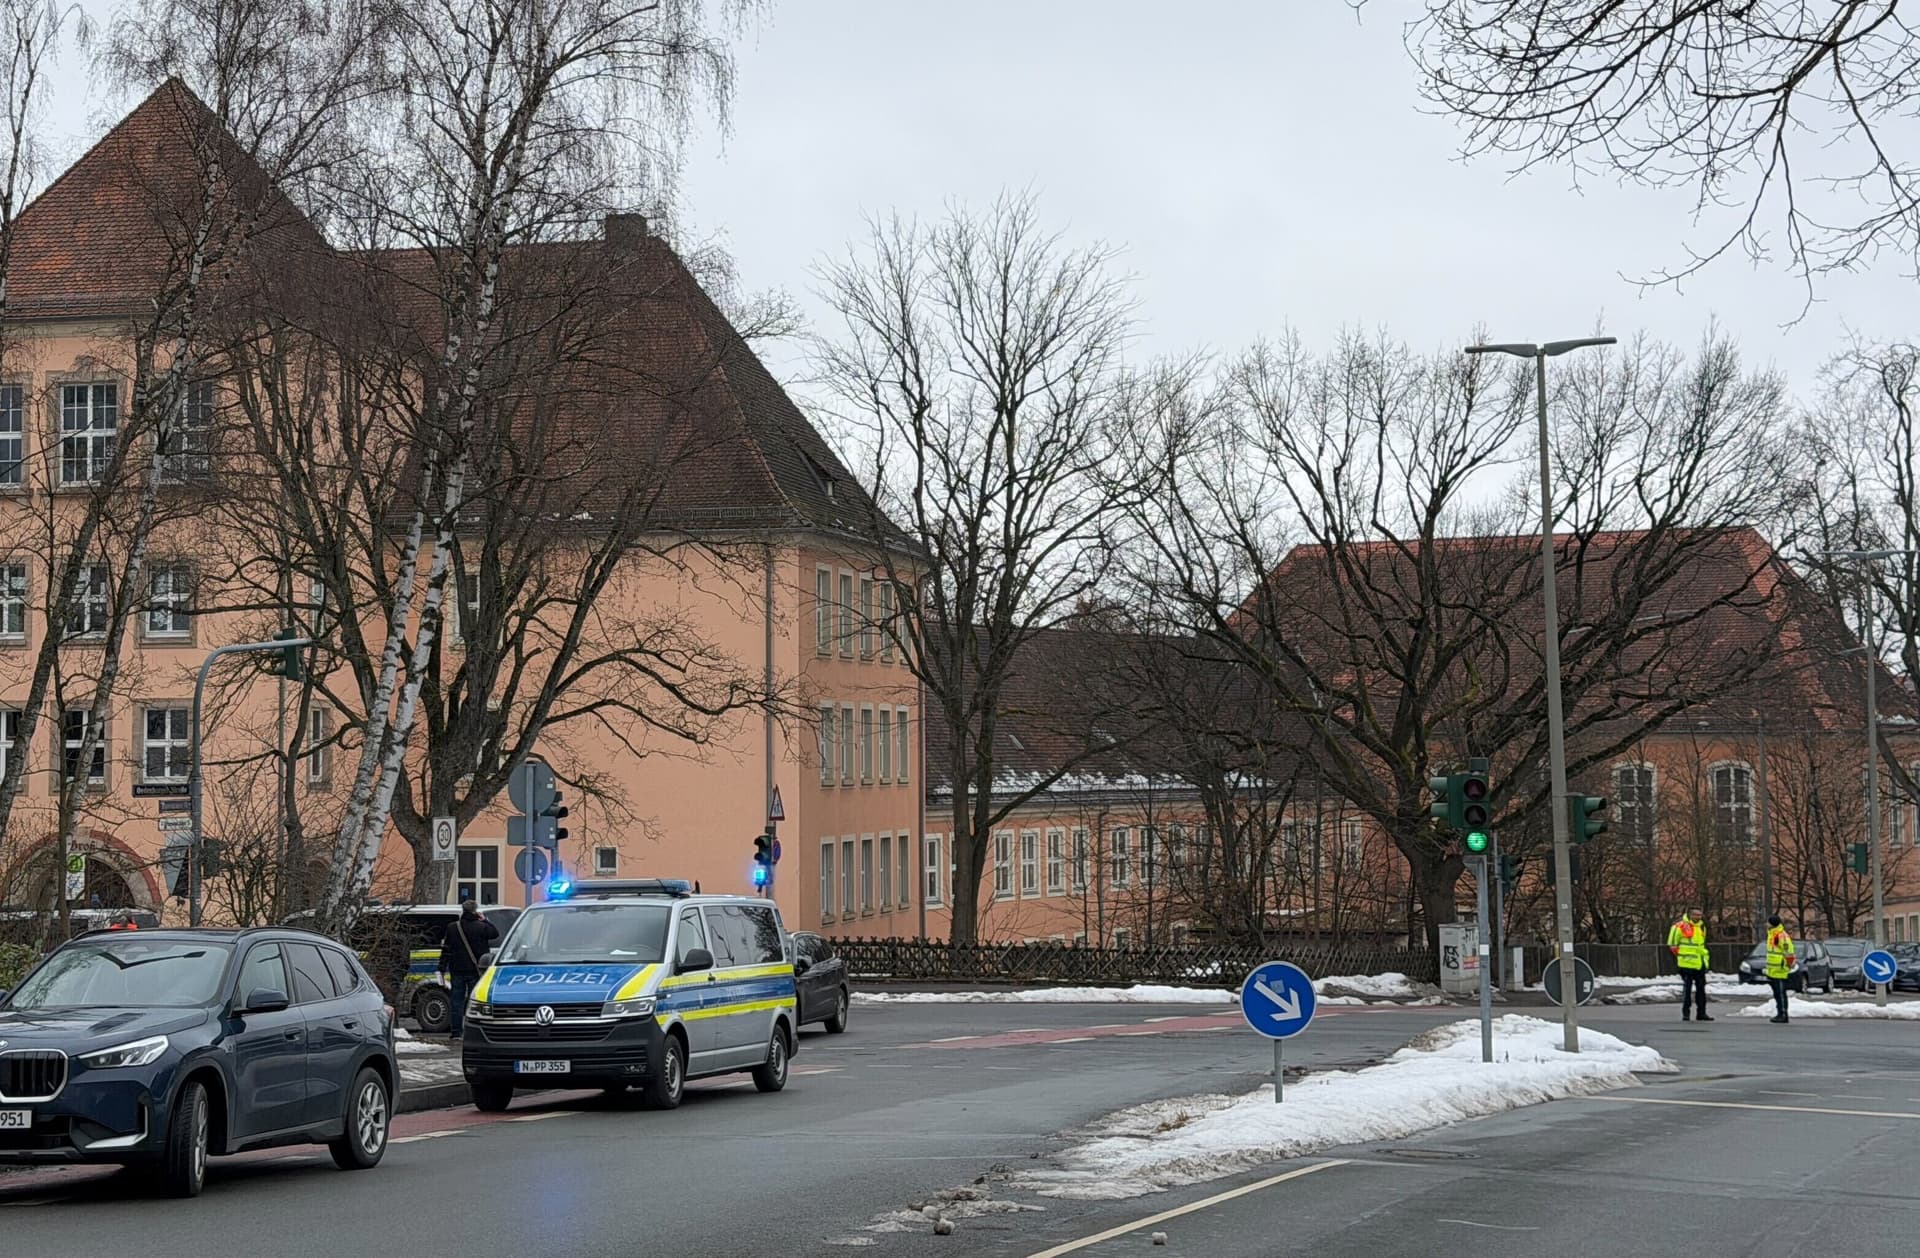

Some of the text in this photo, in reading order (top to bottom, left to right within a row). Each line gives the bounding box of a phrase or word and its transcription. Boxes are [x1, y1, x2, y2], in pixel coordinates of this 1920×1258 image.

[440, 828, 449, 842] 30
[508, 973, 608, 986] POLIZEI
[522, 1062, 566, 1071] N PP 355
[0, 1112, 25, 1126] 951
